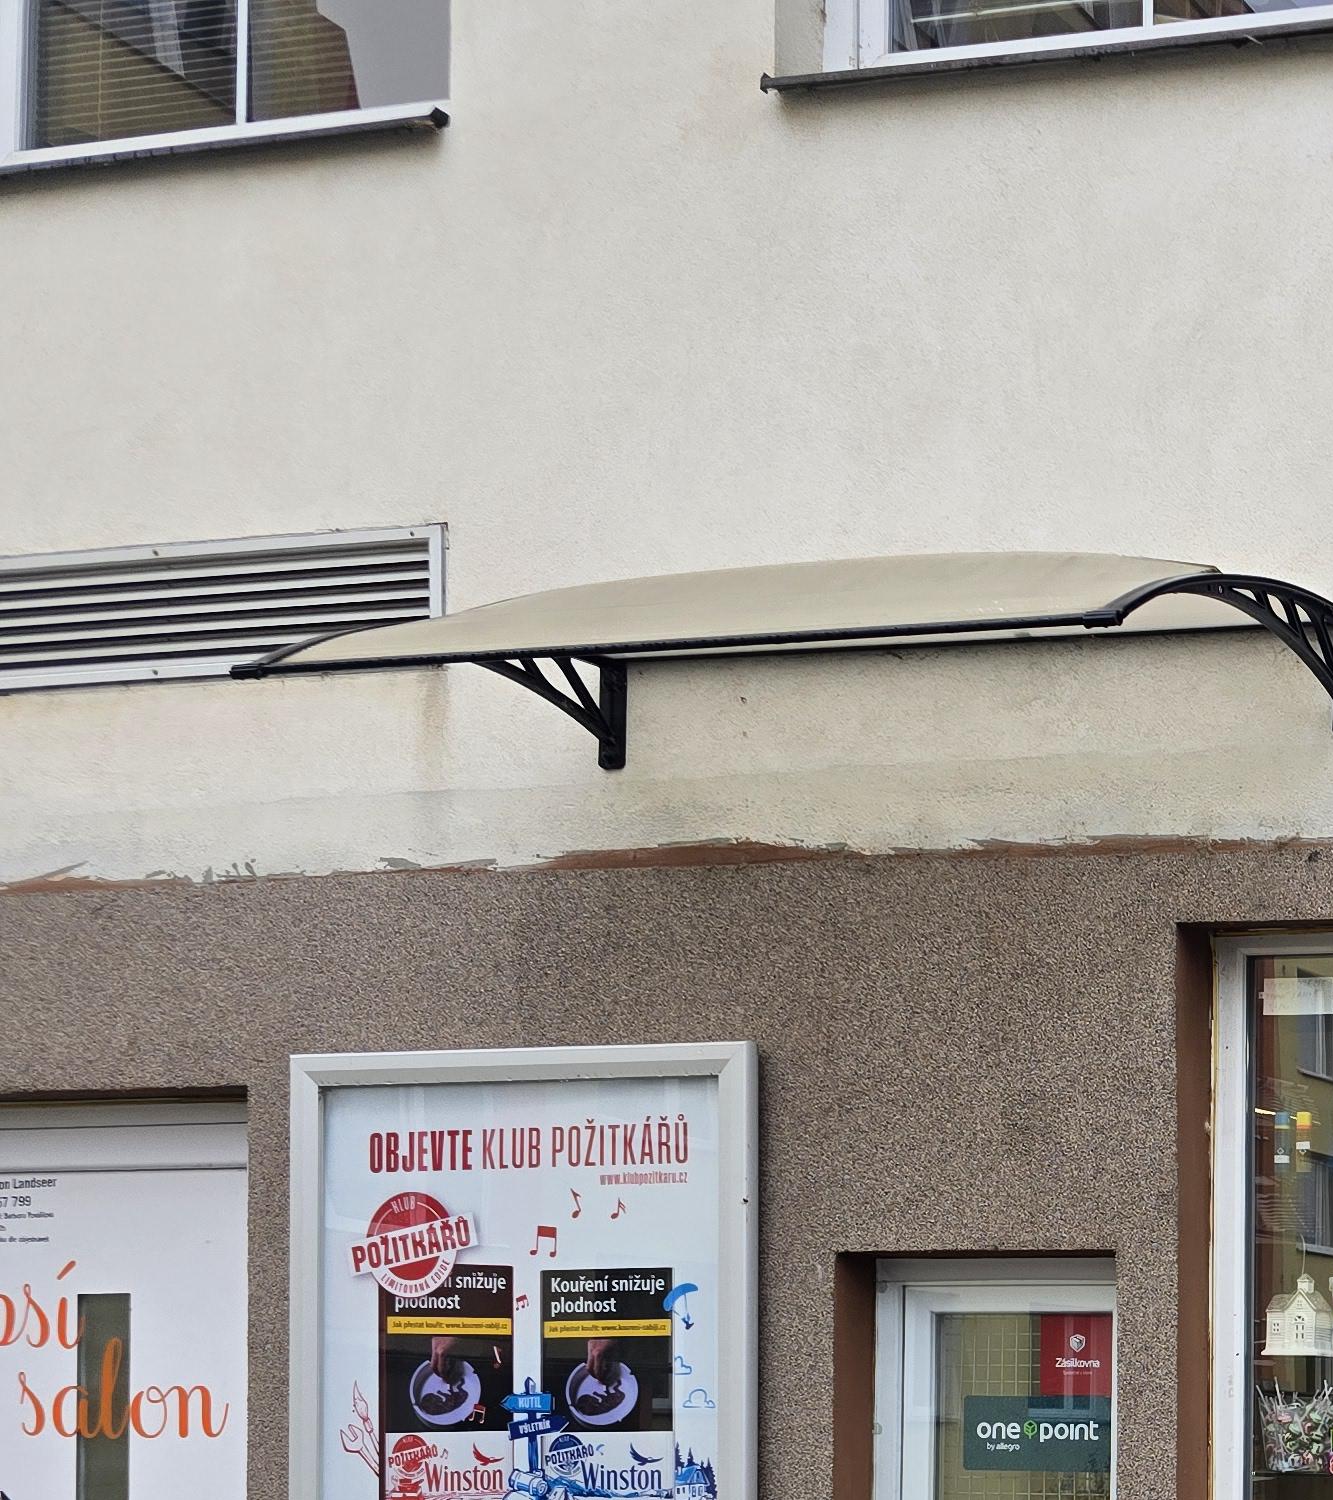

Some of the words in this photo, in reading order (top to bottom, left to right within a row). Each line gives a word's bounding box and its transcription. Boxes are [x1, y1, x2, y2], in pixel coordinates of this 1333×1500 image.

[369, 1129, 473, 1173] OBJEVTE
[482, 1128, 541, 1169] KLUB
[552, 1113, 688, 1168] POŽITKÁŘŮ
[12, 1177, 57, 1189] Landseer
[599, 1171, 688, 1186] www.klubpozitkaru.cz
[11, 1196, 31, 1207] 799
[392, 1195, 417, 1213] KLUB
[352, 1216, 472, 1272] POŽITKÁŘŮ
[455, 1272, 507, 1293] snižuje
[551, 1275, 609, 1293] Kouření
[611, 1274, 665, 1294] snižuje
[395, 1294, 461, 1312] plodnost
[551, 1297, 617, 1318] plodnost
[1055, 1358, 1101, 1368] Zásilkovna
[19, 1337, 229, 1439] salon
[976, 1421, 1021, 1440] one
[1039, 1420, 1100, 1443] point
[986, 1442, 995, 1451] by
[996, 1442, 1020, 1452] allegro
[425, 1461, 503, 1492] Winston
[580, 1461, 662, 1491] Winston
